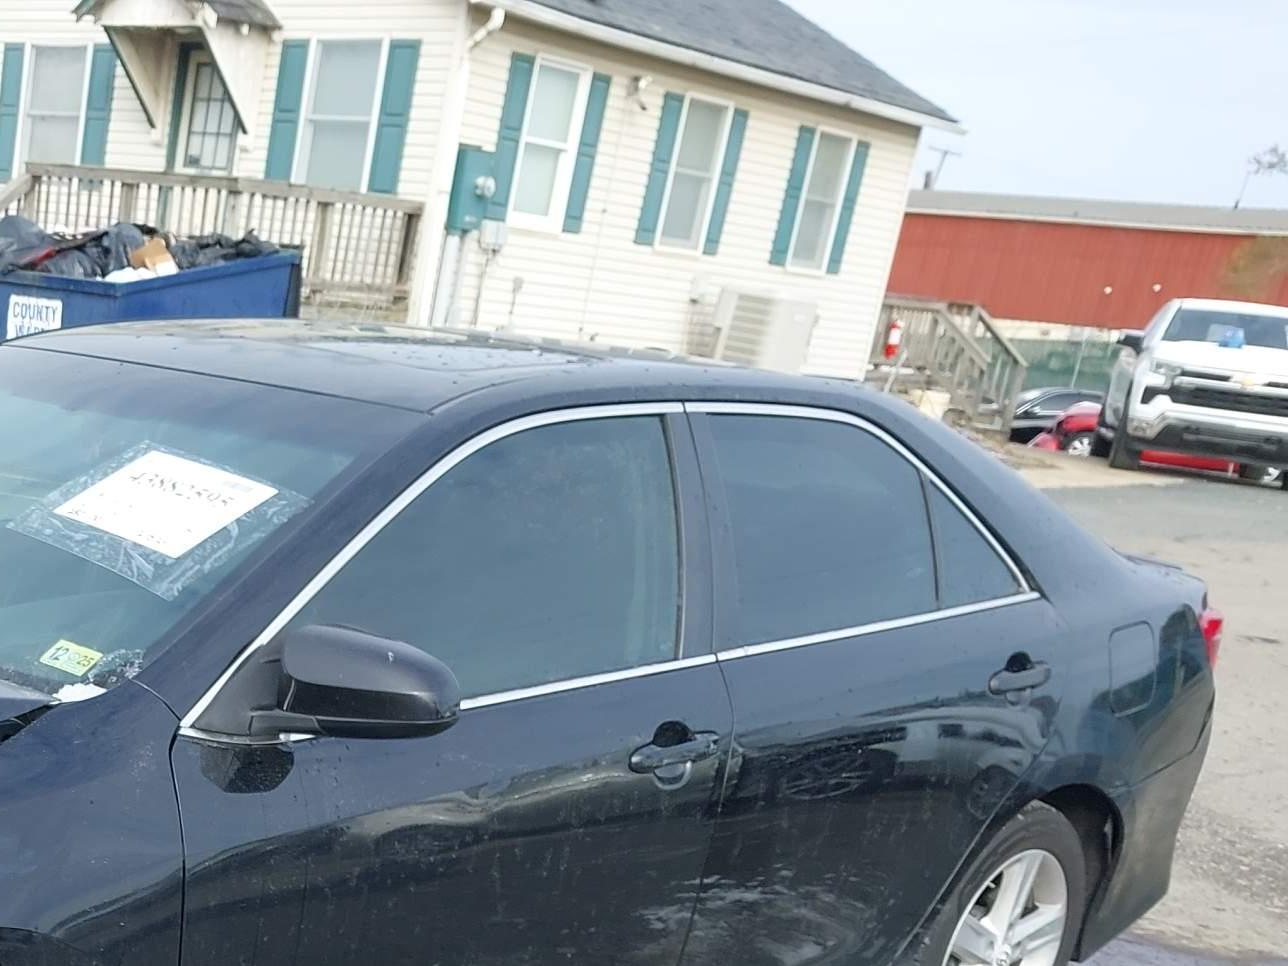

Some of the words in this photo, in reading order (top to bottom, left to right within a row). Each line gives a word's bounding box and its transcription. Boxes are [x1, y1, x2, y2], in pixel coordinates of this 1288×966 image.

[13, 302, 58, 322] COUNTY
[48, 645, 70, 661] 12
[76, 655, 96, 668] 25
